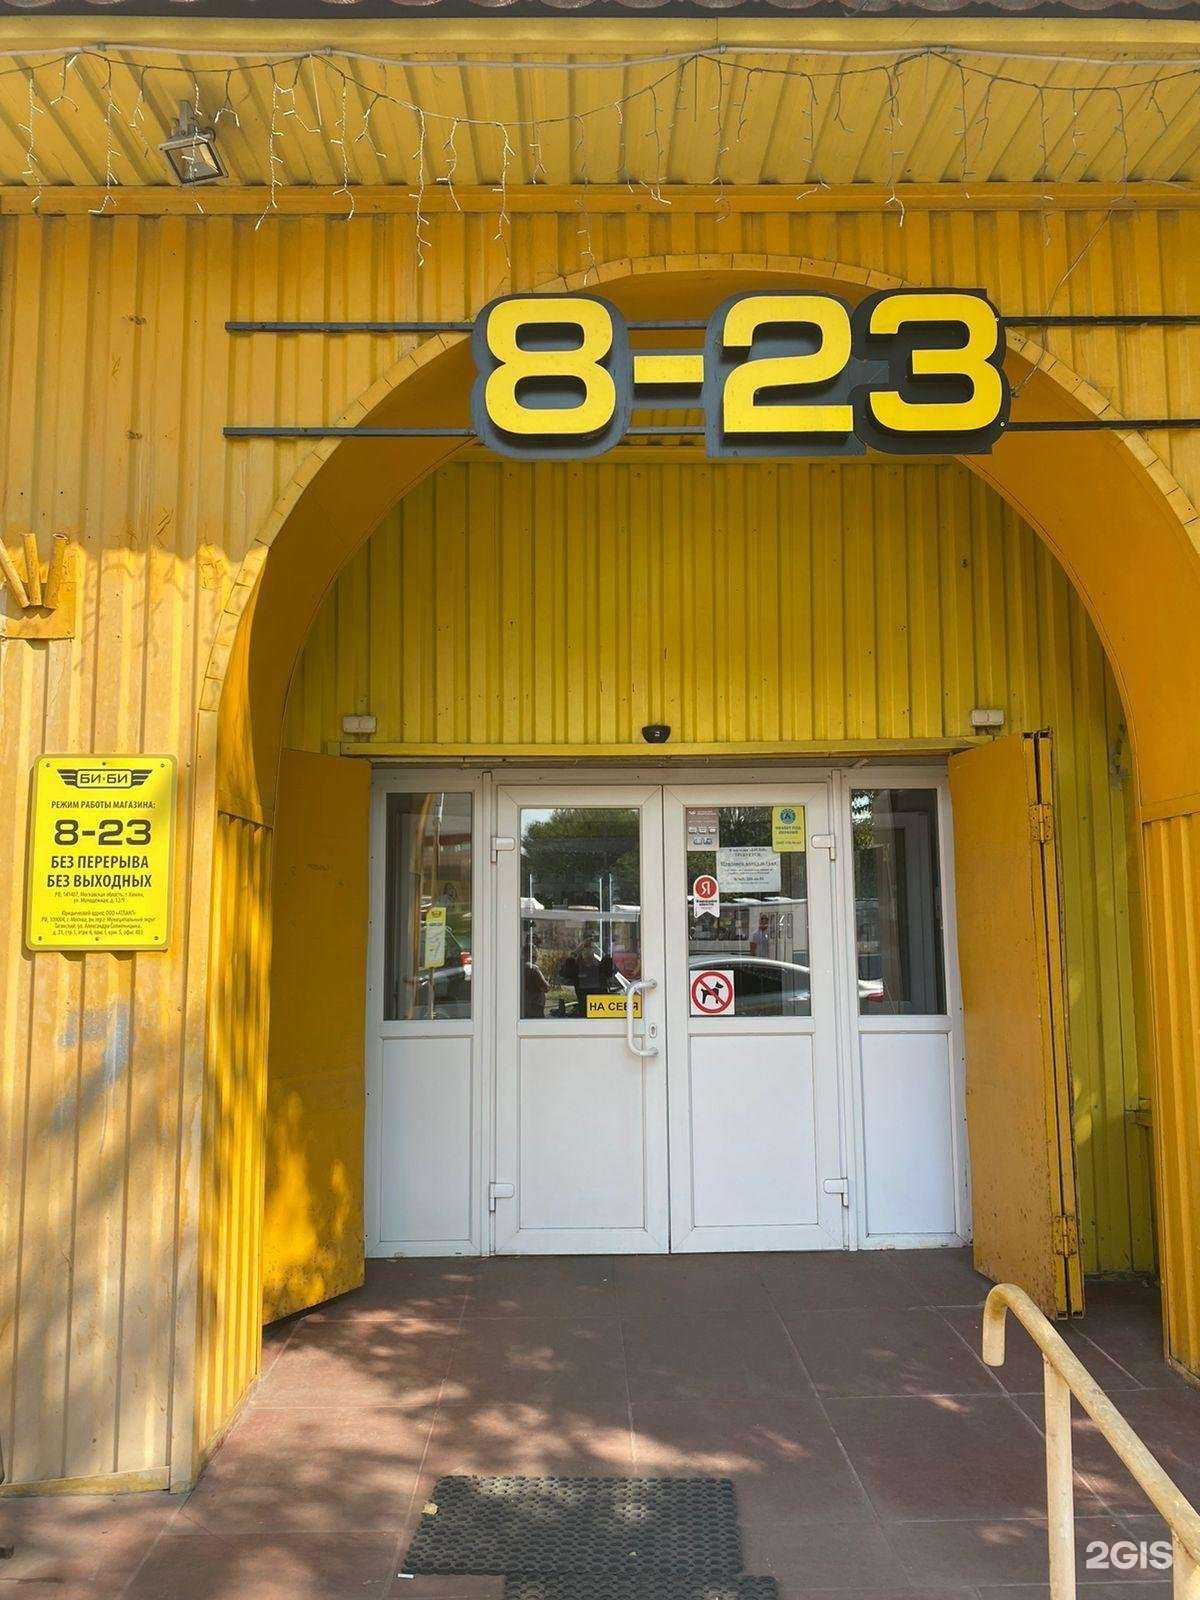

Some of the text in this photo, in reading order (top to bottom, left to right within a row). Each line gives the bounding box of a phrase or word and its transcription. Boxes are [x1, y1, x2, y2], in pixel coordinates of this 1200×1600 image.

[484, 293, 1003, 435] 8-23
[51, 800, 156, 809] РЕЖИМ РАБОТЫ МАГАЗИНА:
[54, 819, 151, 846] 8-23
[51, 856, 149, 869] БЕЗ ПЕРЕРЫВА
[47, 874, 152, 889] БЕЗ ВЫХОДНЫХ
[590, 1002, 605, 1011] НА
